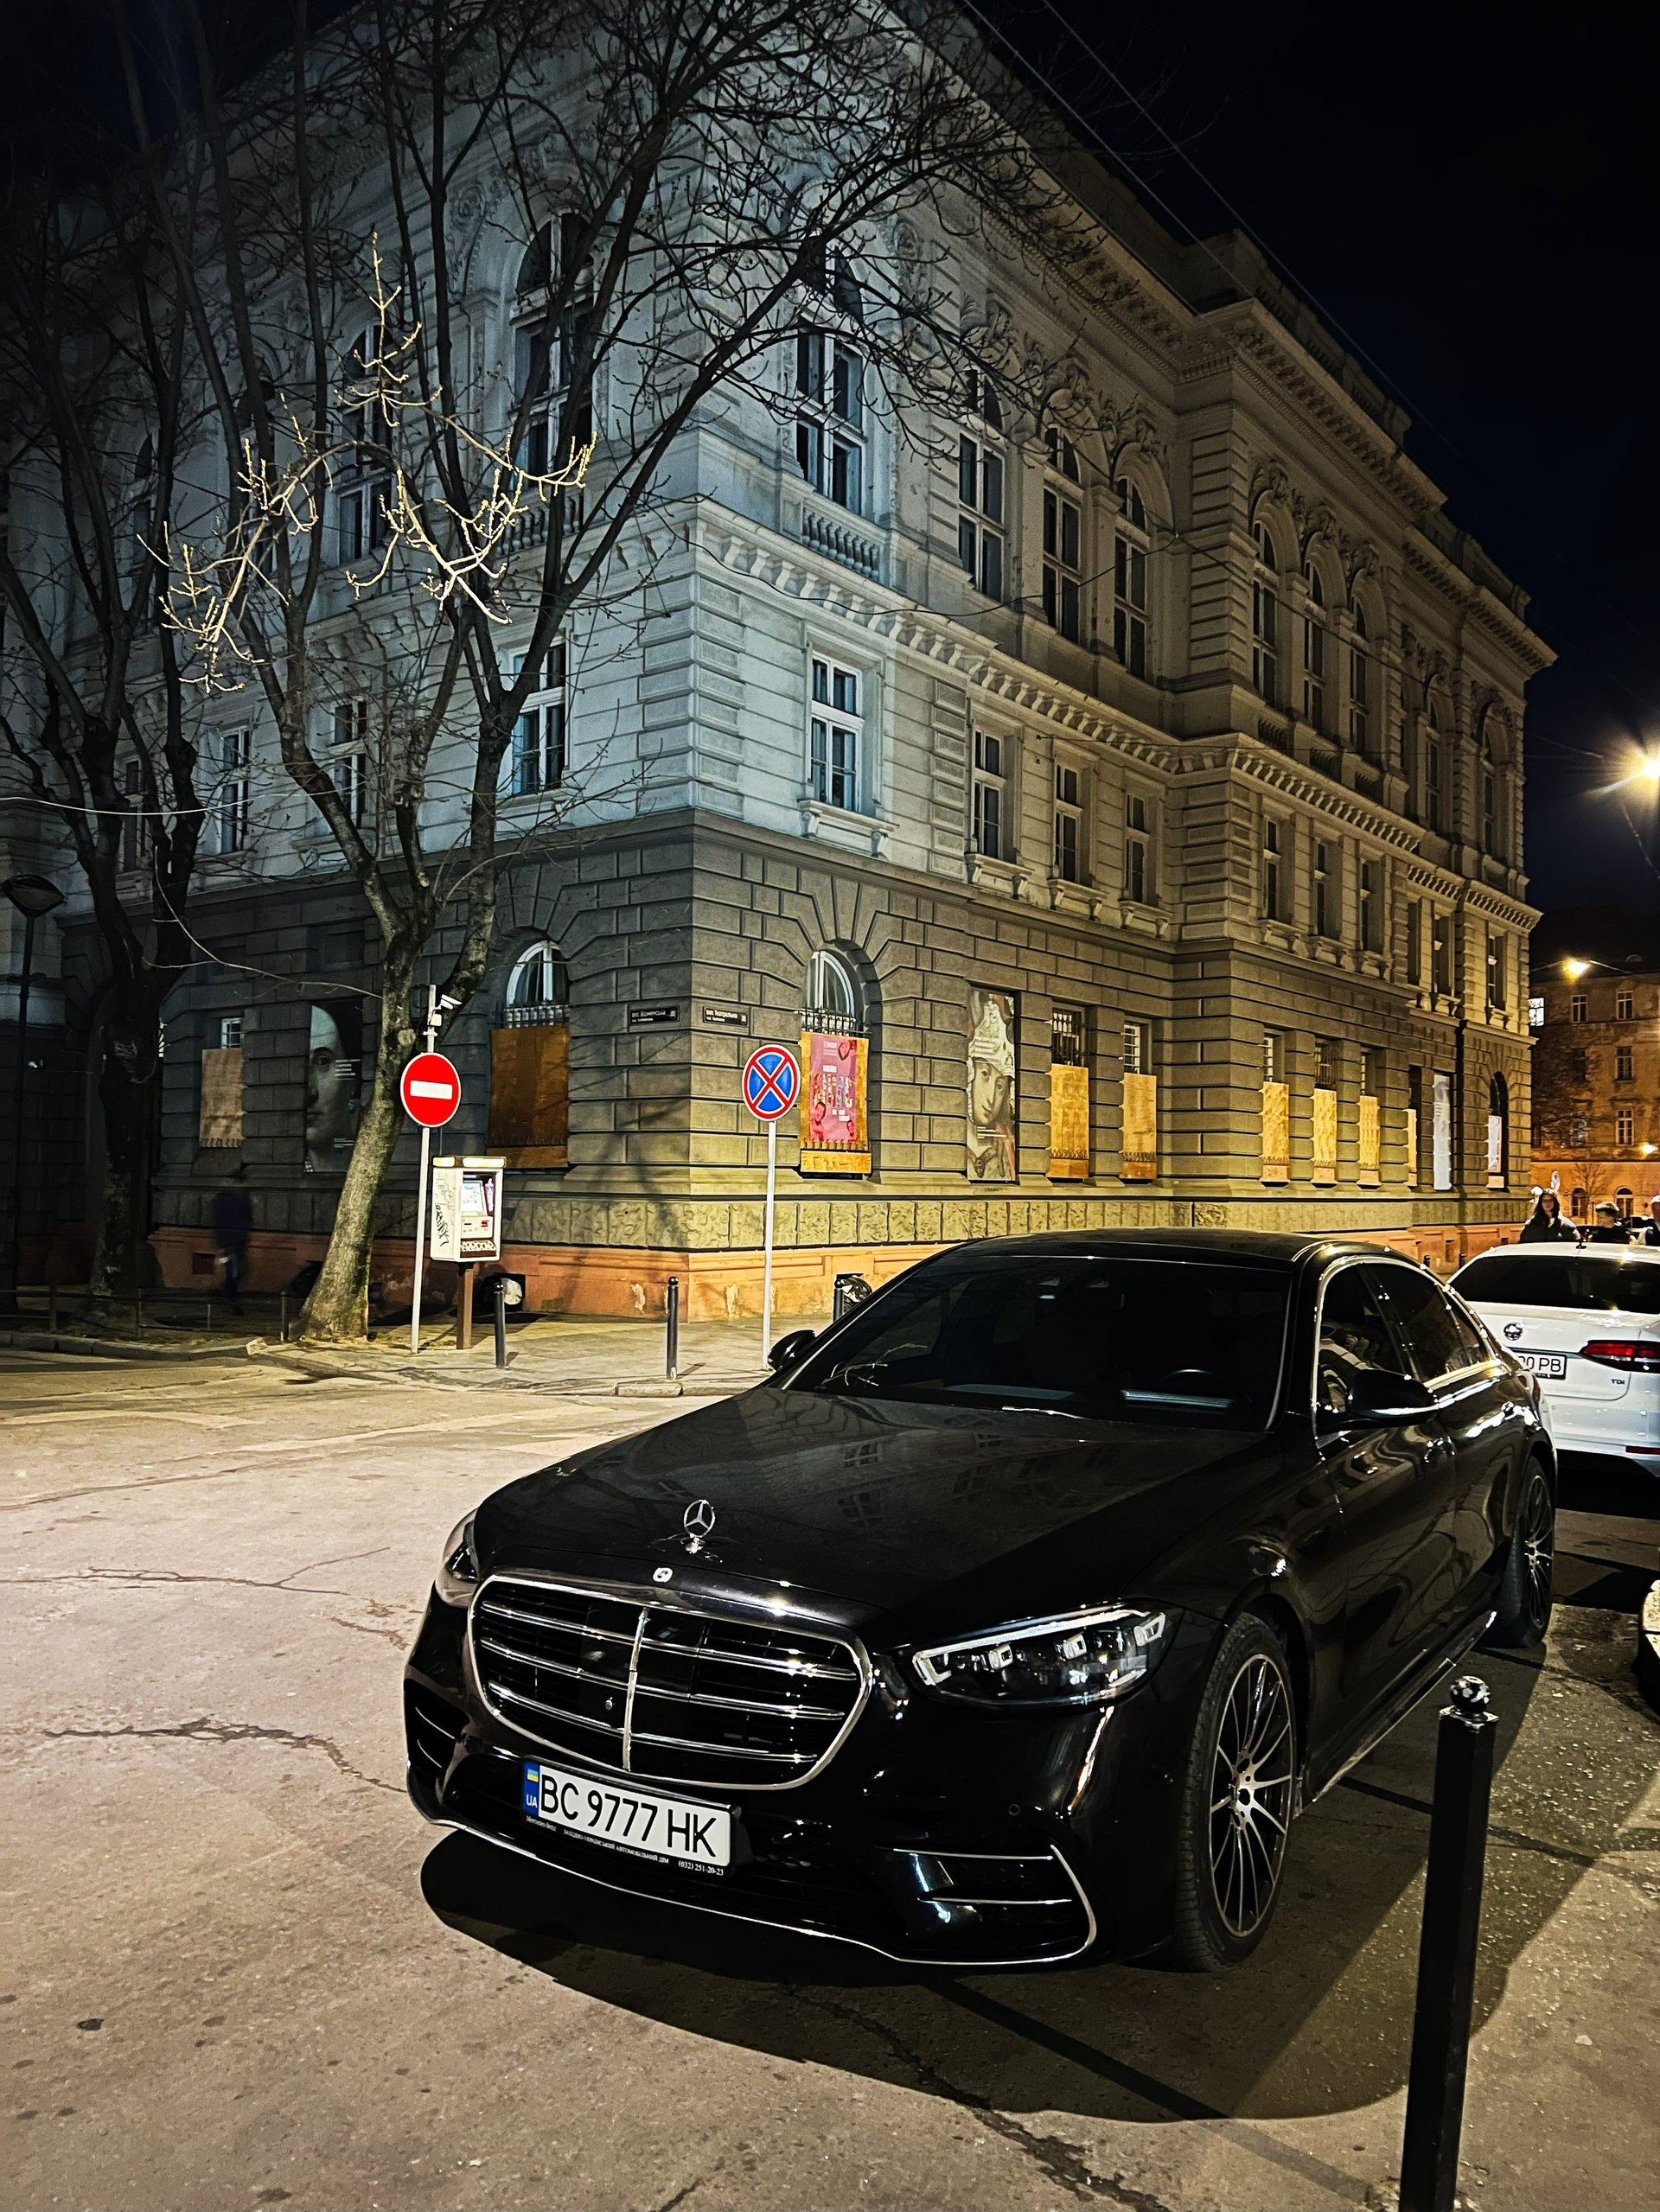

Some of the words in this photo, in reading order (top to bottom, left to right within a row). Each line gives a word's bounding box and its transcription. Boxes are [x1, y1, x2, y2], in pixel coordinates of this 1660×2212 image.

[1539, 1357, 1561, 1373] PB
[526, 1794, 538, 1808] UA
[540, 1774, 579, 1820] BC
[587, 1790, 658, 1842] 9777
[667, 1808, 717, 1858] HK
[678, 1860, 694, 1871] (032)
[694, 1864, 724, 1876] 251-20-23
